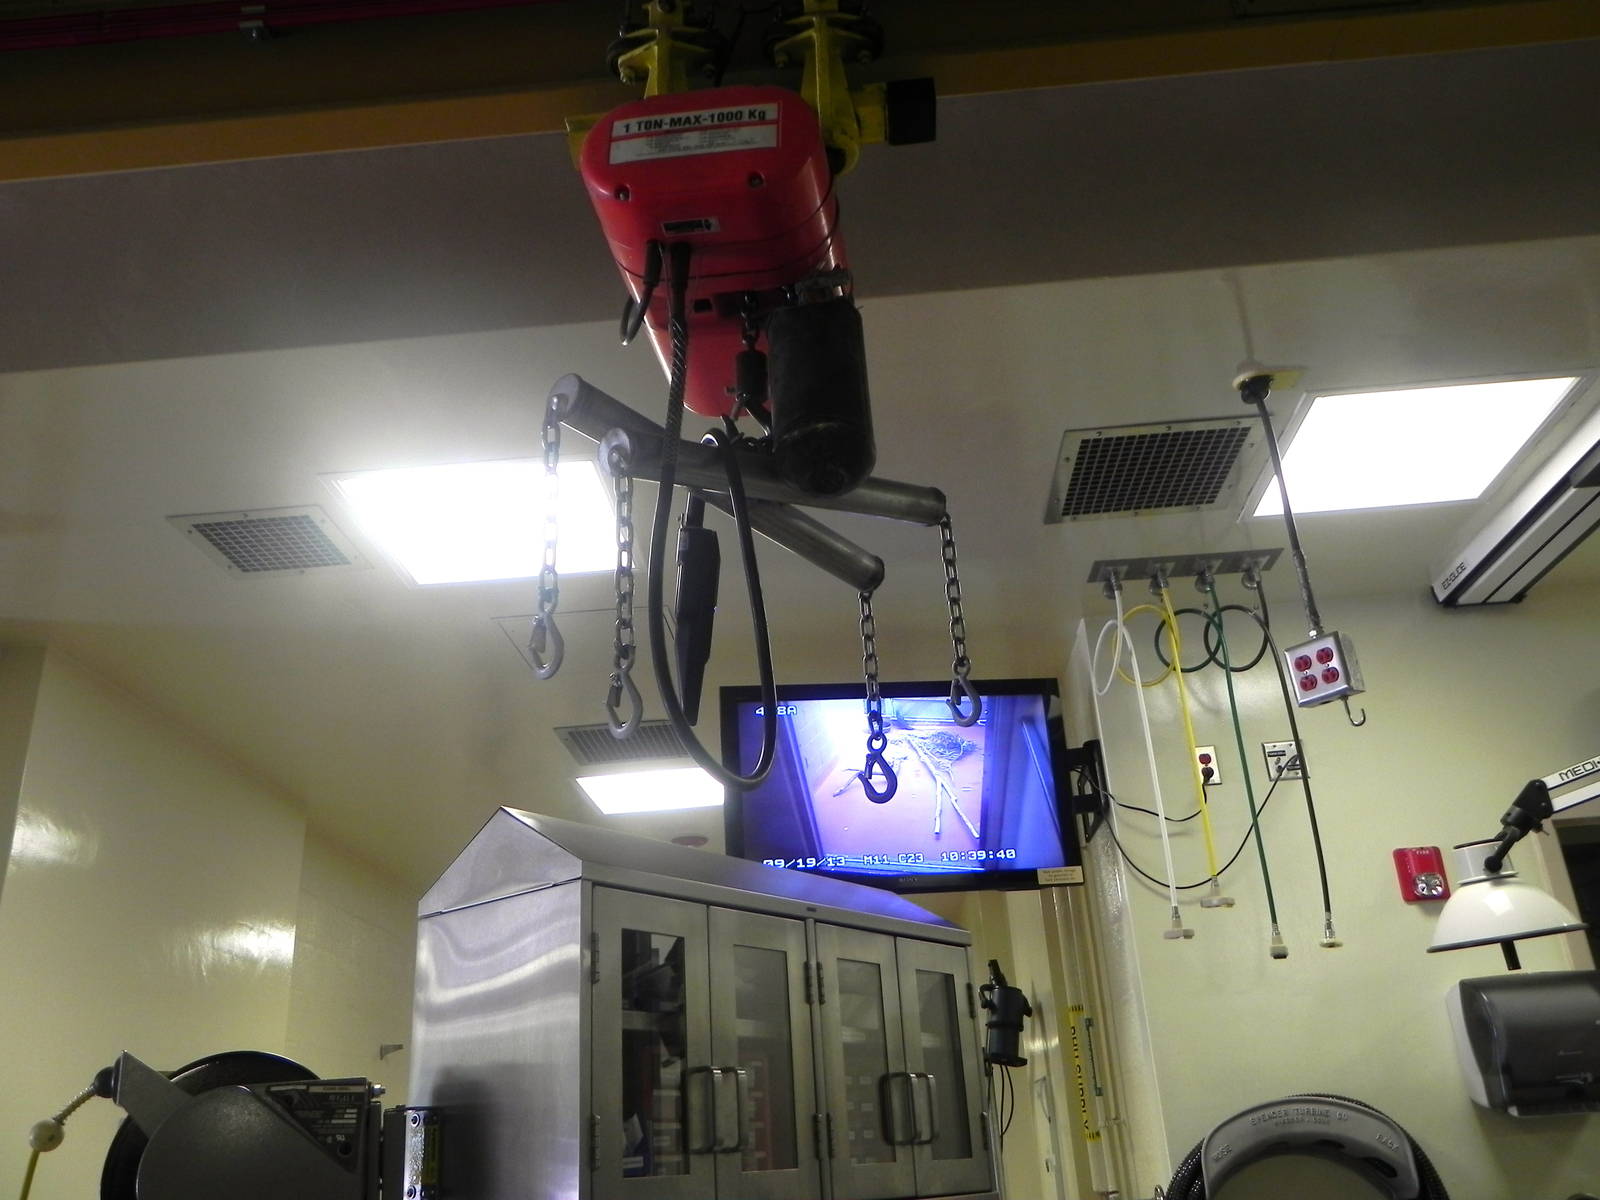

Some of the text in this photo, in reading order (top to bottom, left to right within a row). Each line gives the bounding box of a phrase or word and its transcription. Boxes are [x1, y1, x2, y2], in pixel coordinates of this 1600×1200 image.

[623, 108, 766, 133] 1 TON-MAX-1000 Kg
[755, 706, 797, 716] 48A
[762, 849, 1016, 869] 09/19/13 M11 C23 10:39:40
